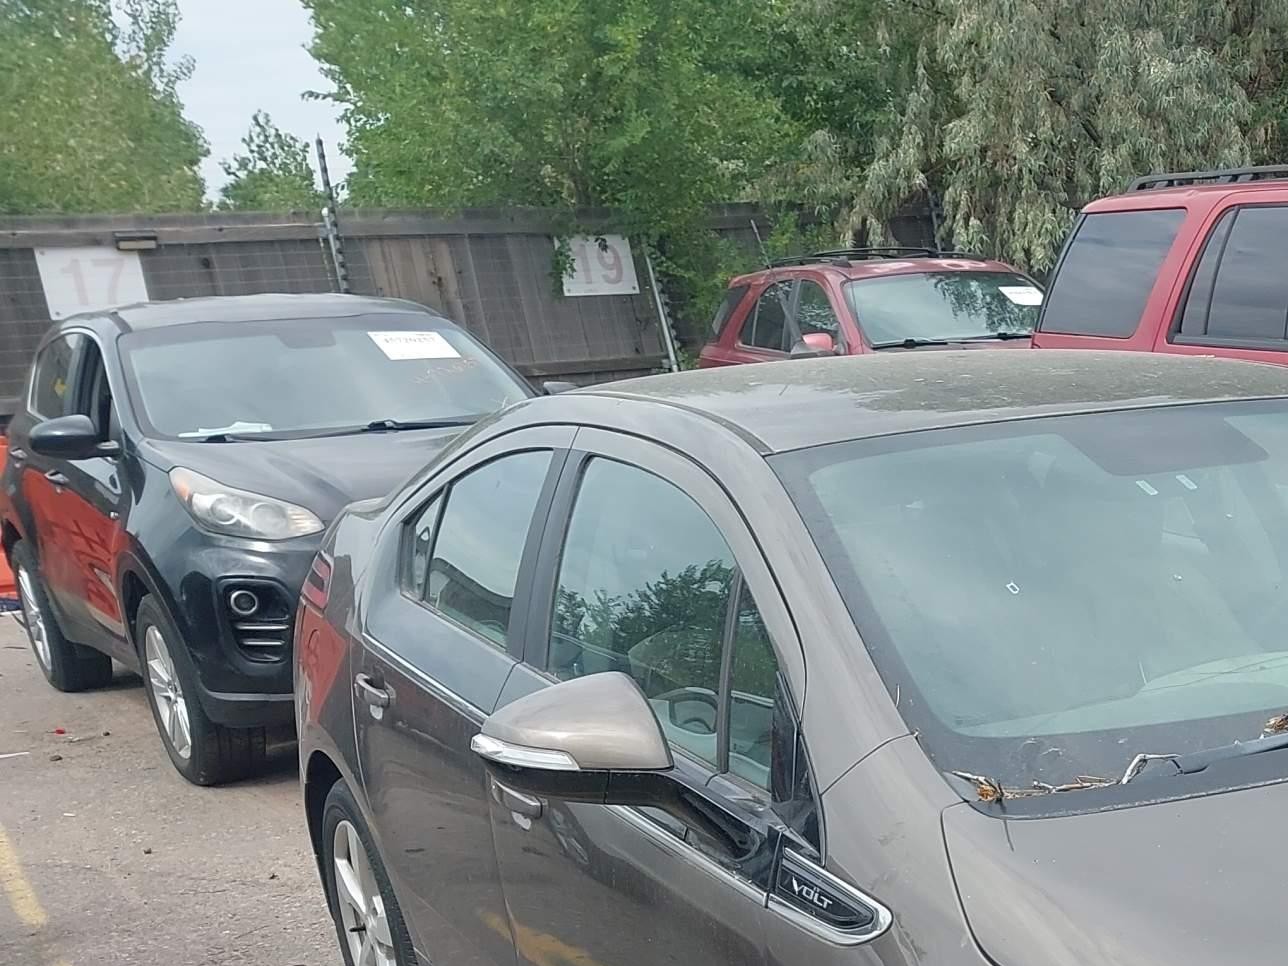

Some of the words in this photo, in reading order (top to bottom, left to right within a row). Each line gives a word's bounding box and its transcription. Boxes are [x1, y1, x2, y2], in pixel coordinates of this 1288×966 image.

[60, 258, 128, 306] 17
[575, 244, 624, 285] 19
[792, 876, 834, 909] VOLT
